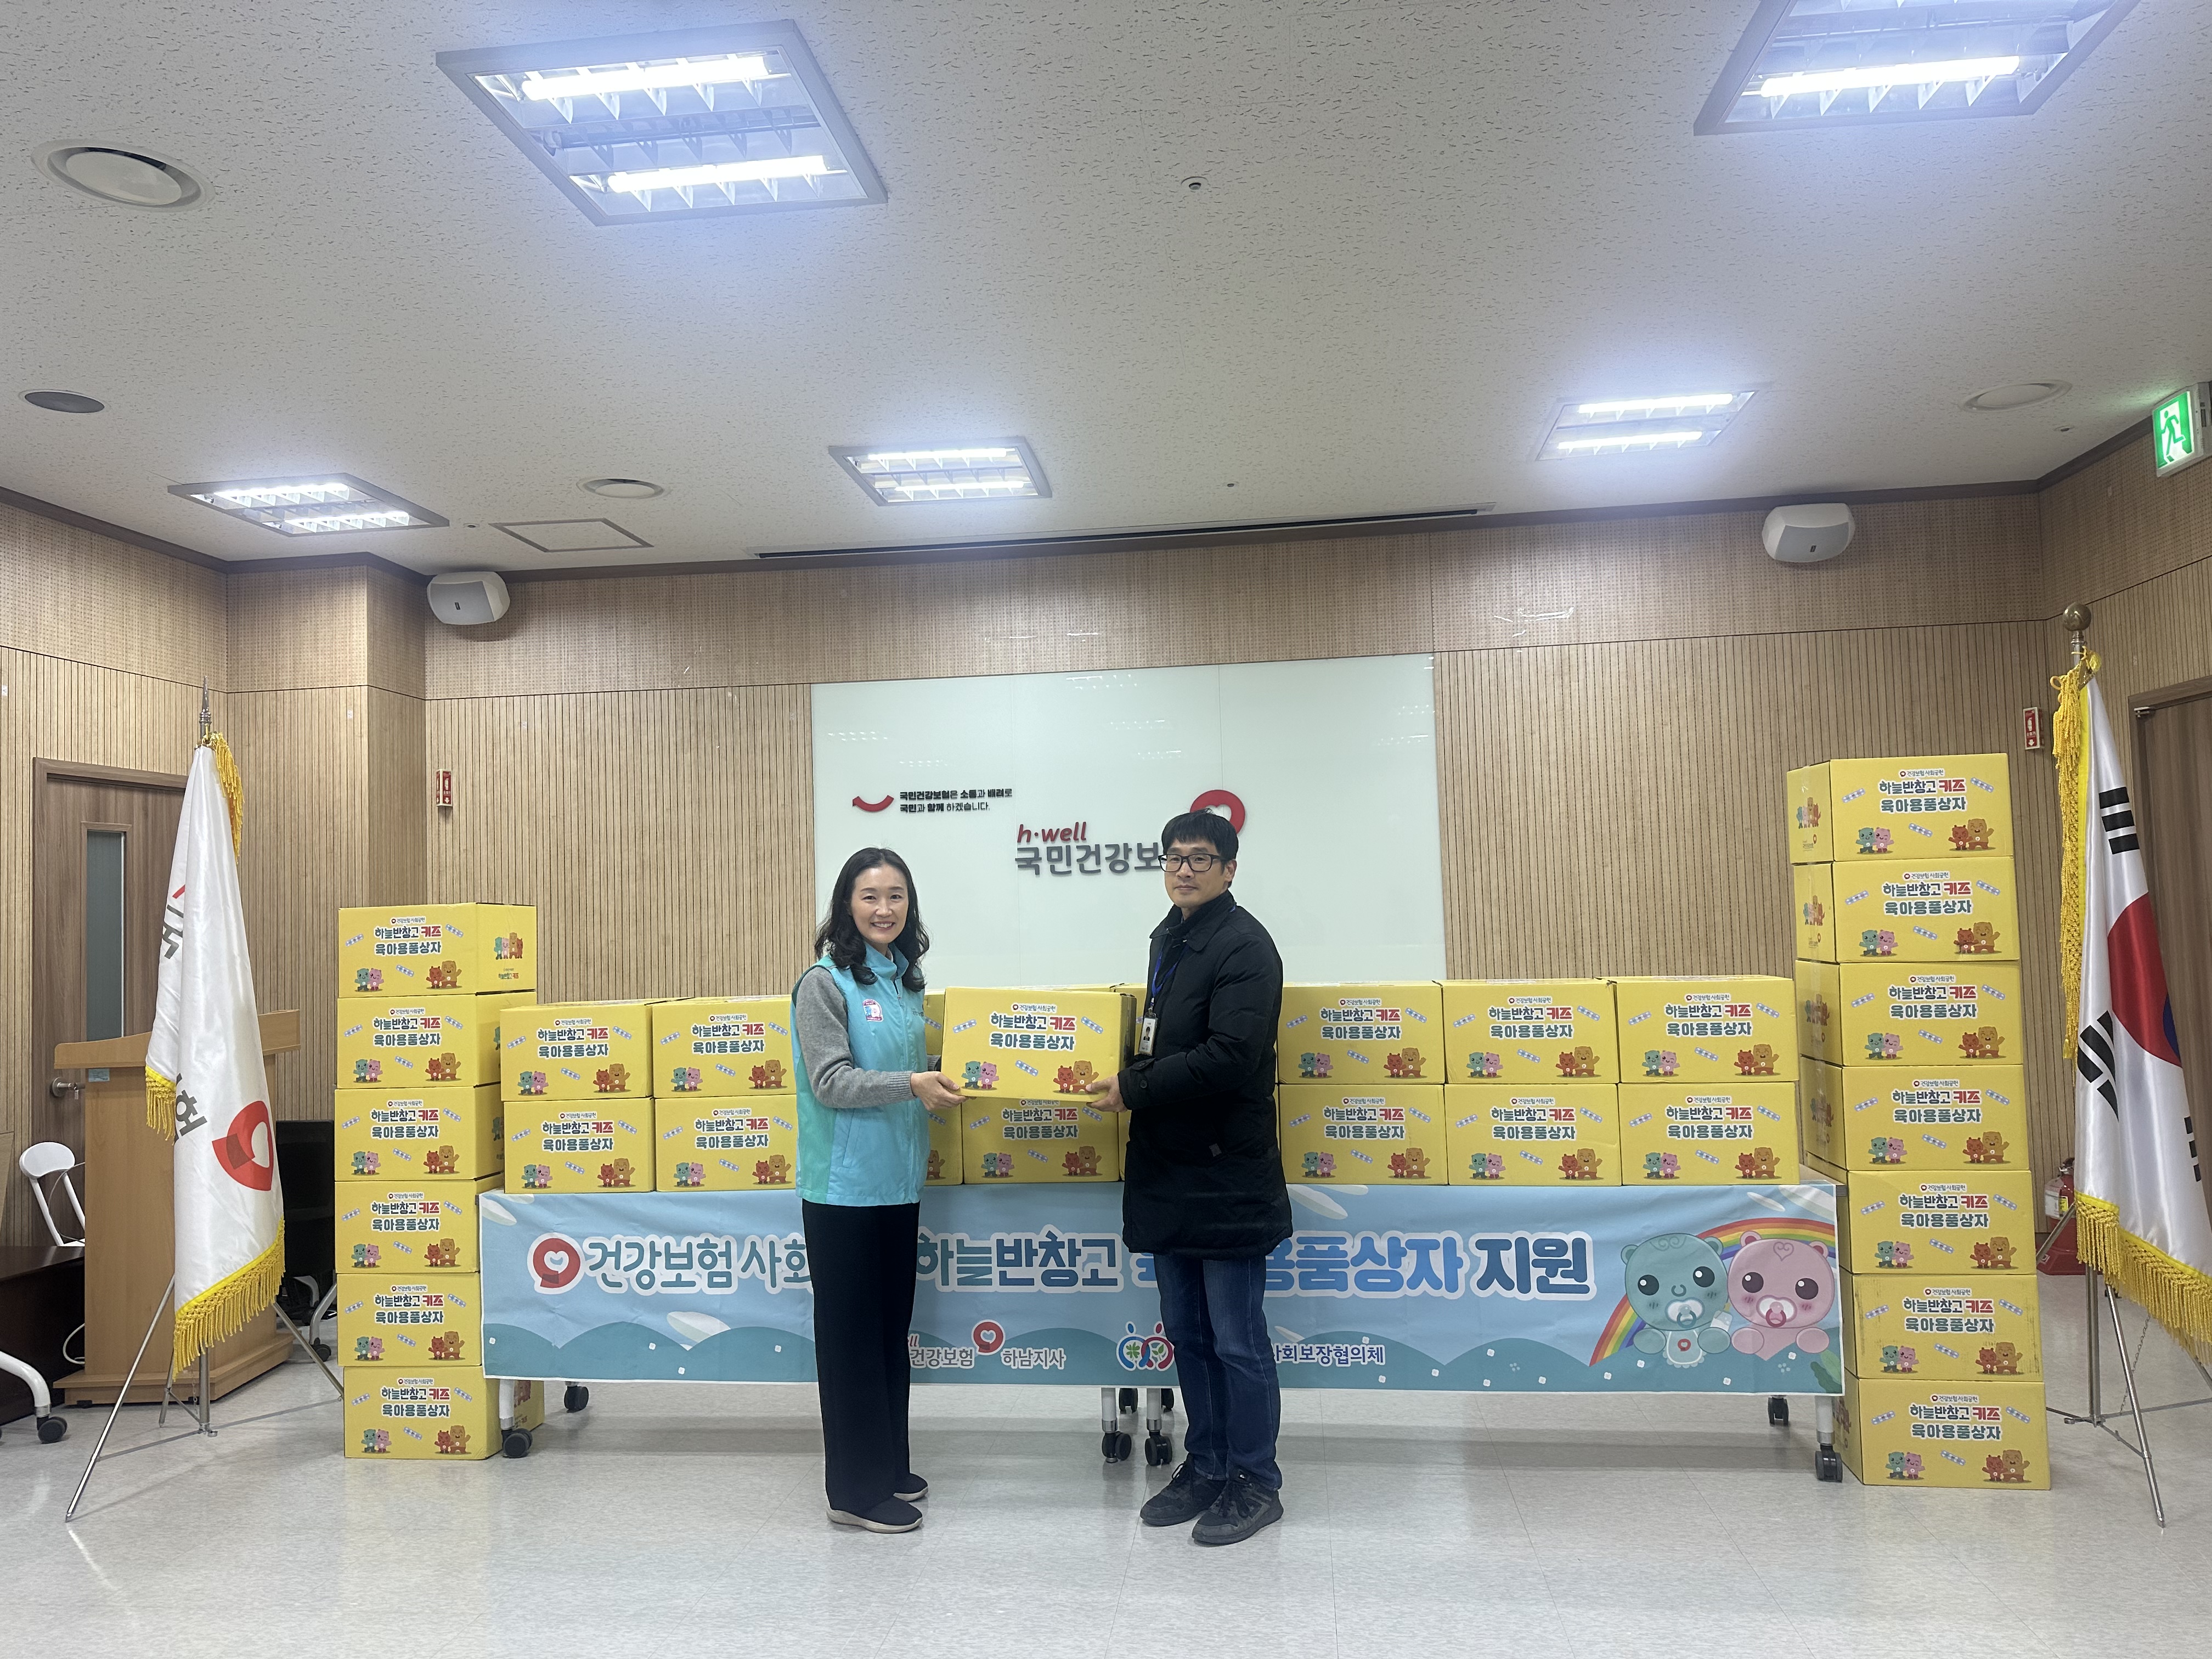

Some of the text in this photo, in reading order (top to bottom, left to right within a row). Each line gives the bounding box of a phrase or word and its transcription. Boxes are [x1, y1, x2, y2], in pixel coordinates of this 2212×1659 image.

[900, 788, 1012, 800] 국민건강보험은 소통과 배려로
[1879, 779, 1966, 795] 하늘반창고 키즈
[900, 802, 990, 812] 국민과 함께 하겠습니다.
[1881, 797, 1966, 813] 육아용품상자
[1015, 842, 1162, 875] 국민건강보
[1883, 882, 1971, 897] 하늘반창고 키즈
[1885, 900, 1972, 916] 육아용품상자
[375, 926, 442, 940] 하늘반창고 키즈
[375, 941, 442, 956] 육아용품상자
[1889, 985, 1977, 1000] 하늘반창고 키즈
[1321, 1008, 1401, 1022] 하늘반창고 키즈
[1489, 1006, 1572, 1021] 하늘반창고 키즈
[1666, 1003, 1751, 1018] 하늘반창고 키즈
[1891, 1004, 1977, 1019] 육아용품상자
[374, 1017, 441, 1030] 하늘반창고 키즈
[991, 1013, 1076, 1031] 하늘반창고 키즈
[1667, 1022, 1752, 1036] 육아용품상자
[538, 1028, 609, 1042] 하늘반창고 키즈
[692, 1023, 764, 1037] 하늘반창고 키즈
[1322, 1026, 1401, 1040] 육아용품상자
[1491, 1024, 1573, 1039] 육아용품상자
[374, 1033, 441, 1047] 육아용품상자
[693, 1040, 765, 1054] 육아용품상자
[991, 1033, 1075, 1051] 육아용품상자
[539, 1043, 609, 1058] 육아용품상자
[1893, 1089, 1980, 1104] 하늘반창고 키즈
[371, 1109, 439, 1122] 하늘반창고 키즈
[1002, 1108, 1077, 1122] 하늘반창고 키즈
[1324, 1107, 1404, 1121] 하늘반창고 키즈
[1491, 1107, 1575, 1122] 하늘반창고 키즈
[1666, 1105, 1752, 1120] 하늘반창고 키즈
[1894, 1109, 1981, 1123] 육아용품상자
[372, 1125, 439, 1139] 육아용품상자
[543, 1121, 614, 1135] 하늘반창고 키즈
[695, 1118, 769, 1132] 하늘반창고 키즈
[1003, 1125, 1078, 1139] 육아용품상자
[1325, 1125, 1405, 1139] 육아용품상자
[1668, 1125, 1753, 1139] 육아용품상자
[1493, 1126, 1576, 1140] 육아용품상자
[543, 1138, 614, 1152] 육아용품상자
[696, 1135, 769, 1149] 육아용품상자
[371, 1201, 440, 1215] 하늘반창고 키즈
[1900, 1194, 1988, 1209] 하늘반창고 키즈
[373, 1218, 440, 1231] 육아용품상자
[1901, 1214, 1989, 1228] 육아용품상자
[588, 1238, 732, 1290] 건강보험
[741, 1239, 812, 1288] 사회
[916, 1230, 1118, 1287] 하늘반창고
[1475, 1237, 1590, 1294] 지원
[375, 1294, 444, 1307] 하늘반창고 키즈
[1904, 1298, 1993, 1313] 하늘반창고 키즈
[376, 1311, 444, 1324] 육아용품상자
[1905, 1318, 1994, 1333] 육아용품상자
[910, 1348, 1064, 1368] 건강보험 하남지사
[381, 1386, 450, 1401] 하늘반창고 키즈
[382, 1404, 450, 1417] 육아용품상자
[1910, 1404, 2000, 1420] 하늘반창고 키즈
[1912, 1424, 2001, 1440] 육아용품상자
